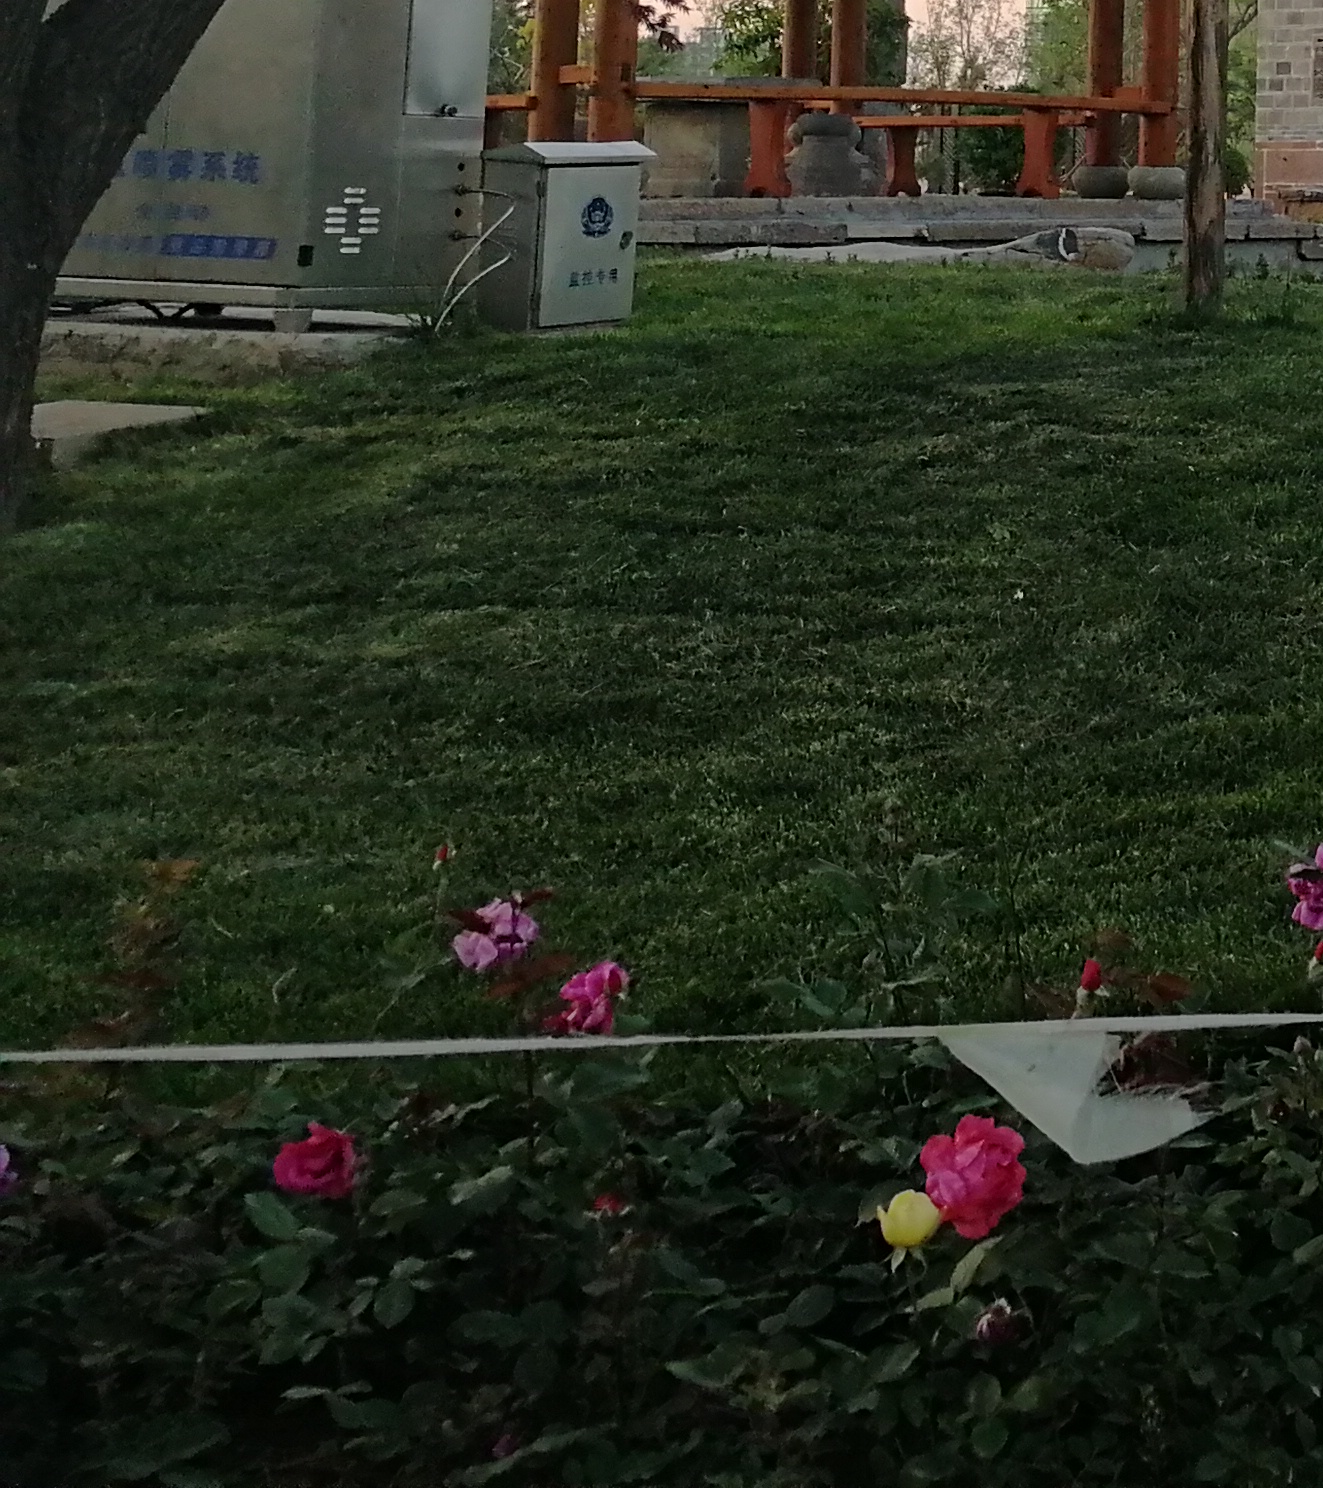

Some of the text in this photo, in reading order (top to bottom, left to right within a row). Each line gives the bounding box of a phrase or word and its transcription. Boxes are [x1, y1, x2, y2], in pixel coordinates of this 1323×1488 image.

[117, 149, 260, 185] 喷雾系统
[569, 268, 618, 287] 监控专用
